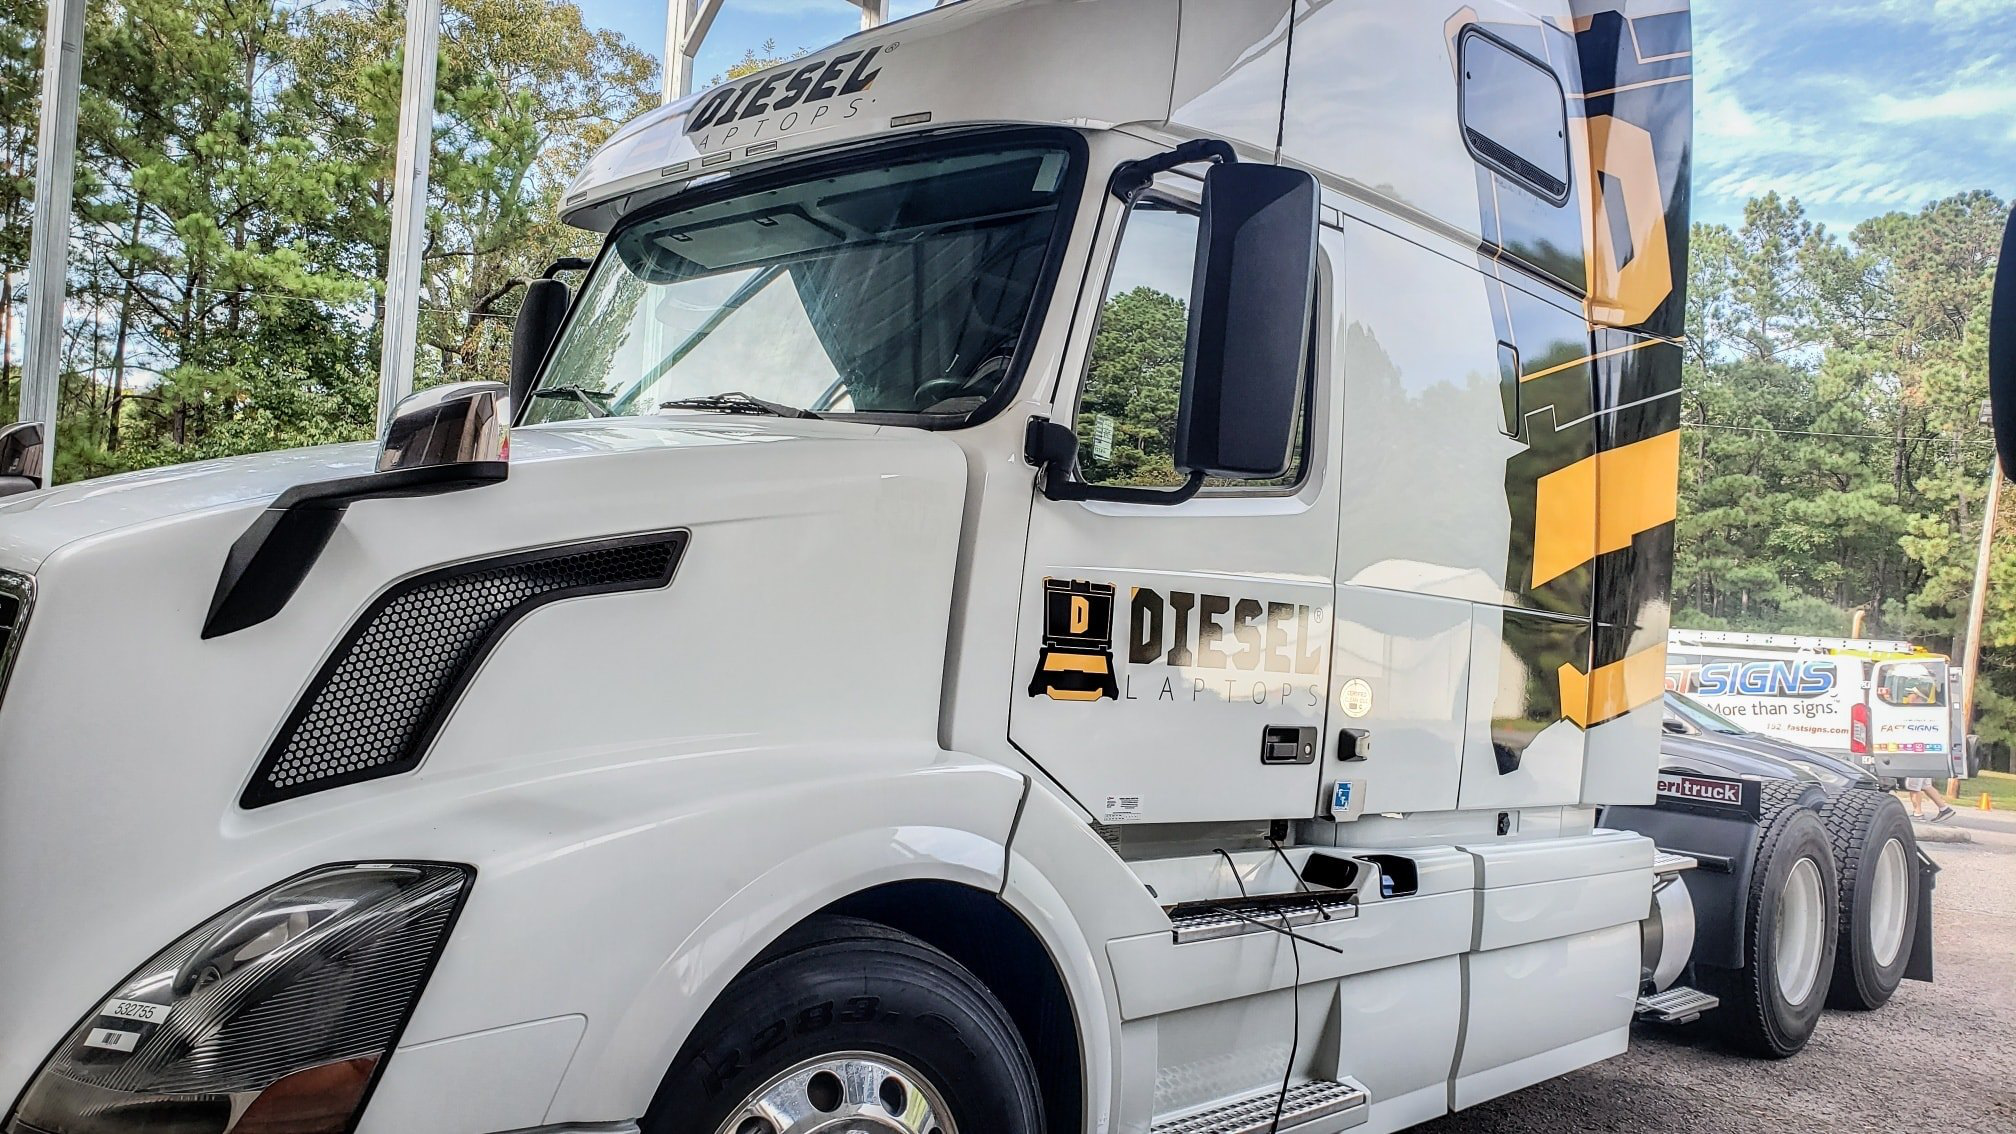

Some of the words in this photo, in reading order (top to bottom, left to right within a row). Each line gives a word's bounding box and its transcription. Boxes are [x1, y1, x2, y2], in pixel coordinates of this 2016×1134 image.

[687, 45, 883, 132] DIESEL
[1128, 586, 1322, 675] DIESEL
[1126, 674, 1319, 707] LAPTOPS
[1752, 701, 1789, 715] than
[114, 1002, 156, 1019] 532755
